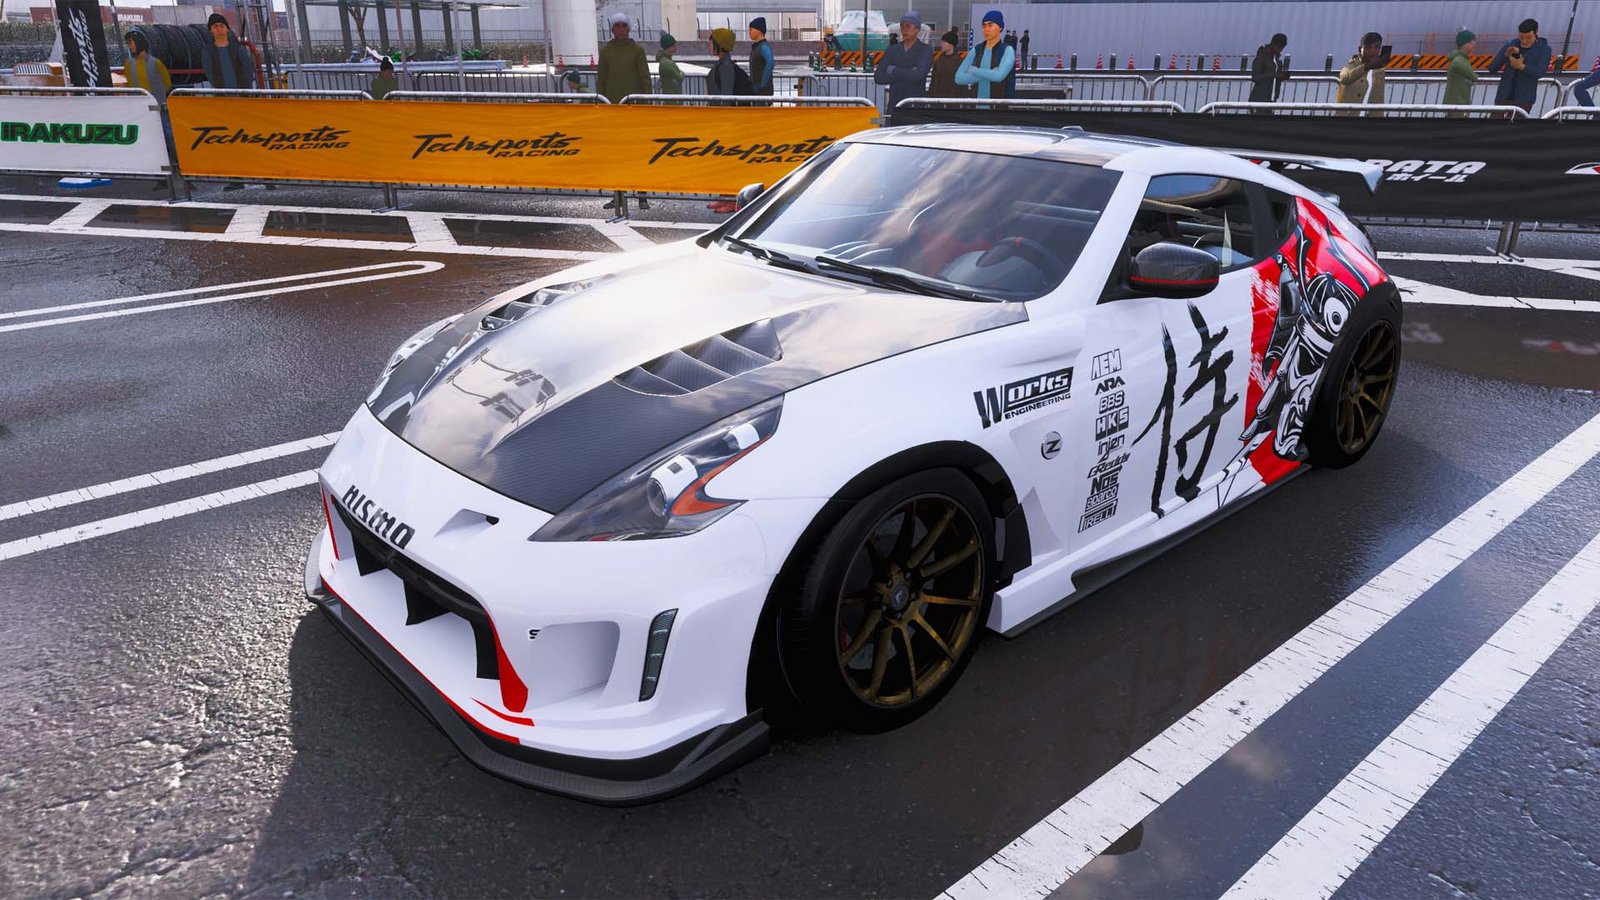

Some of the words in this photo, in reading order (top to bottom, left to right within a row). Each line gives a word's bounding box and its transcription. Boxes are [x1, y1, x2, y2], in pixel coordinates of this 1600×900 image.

[0, 122, 139, 145] IRAKUZU
[191, 125, 351, 151] Techsports
[268, 141, 350, 151] RACING
[411, 131, 583, 160] Techsports
[494, 148, 580, 158] RACING
[1091, 348, 1123, 381] AEM
[973, 366, 1074, 430] Works
[1004, 393, 1072, 420] ENGINEERING
[1099, 389, 1125, 415] BBS
[1095, 406, 1130, 442] HKS
[1090, 465, 1123, 496] NOS
